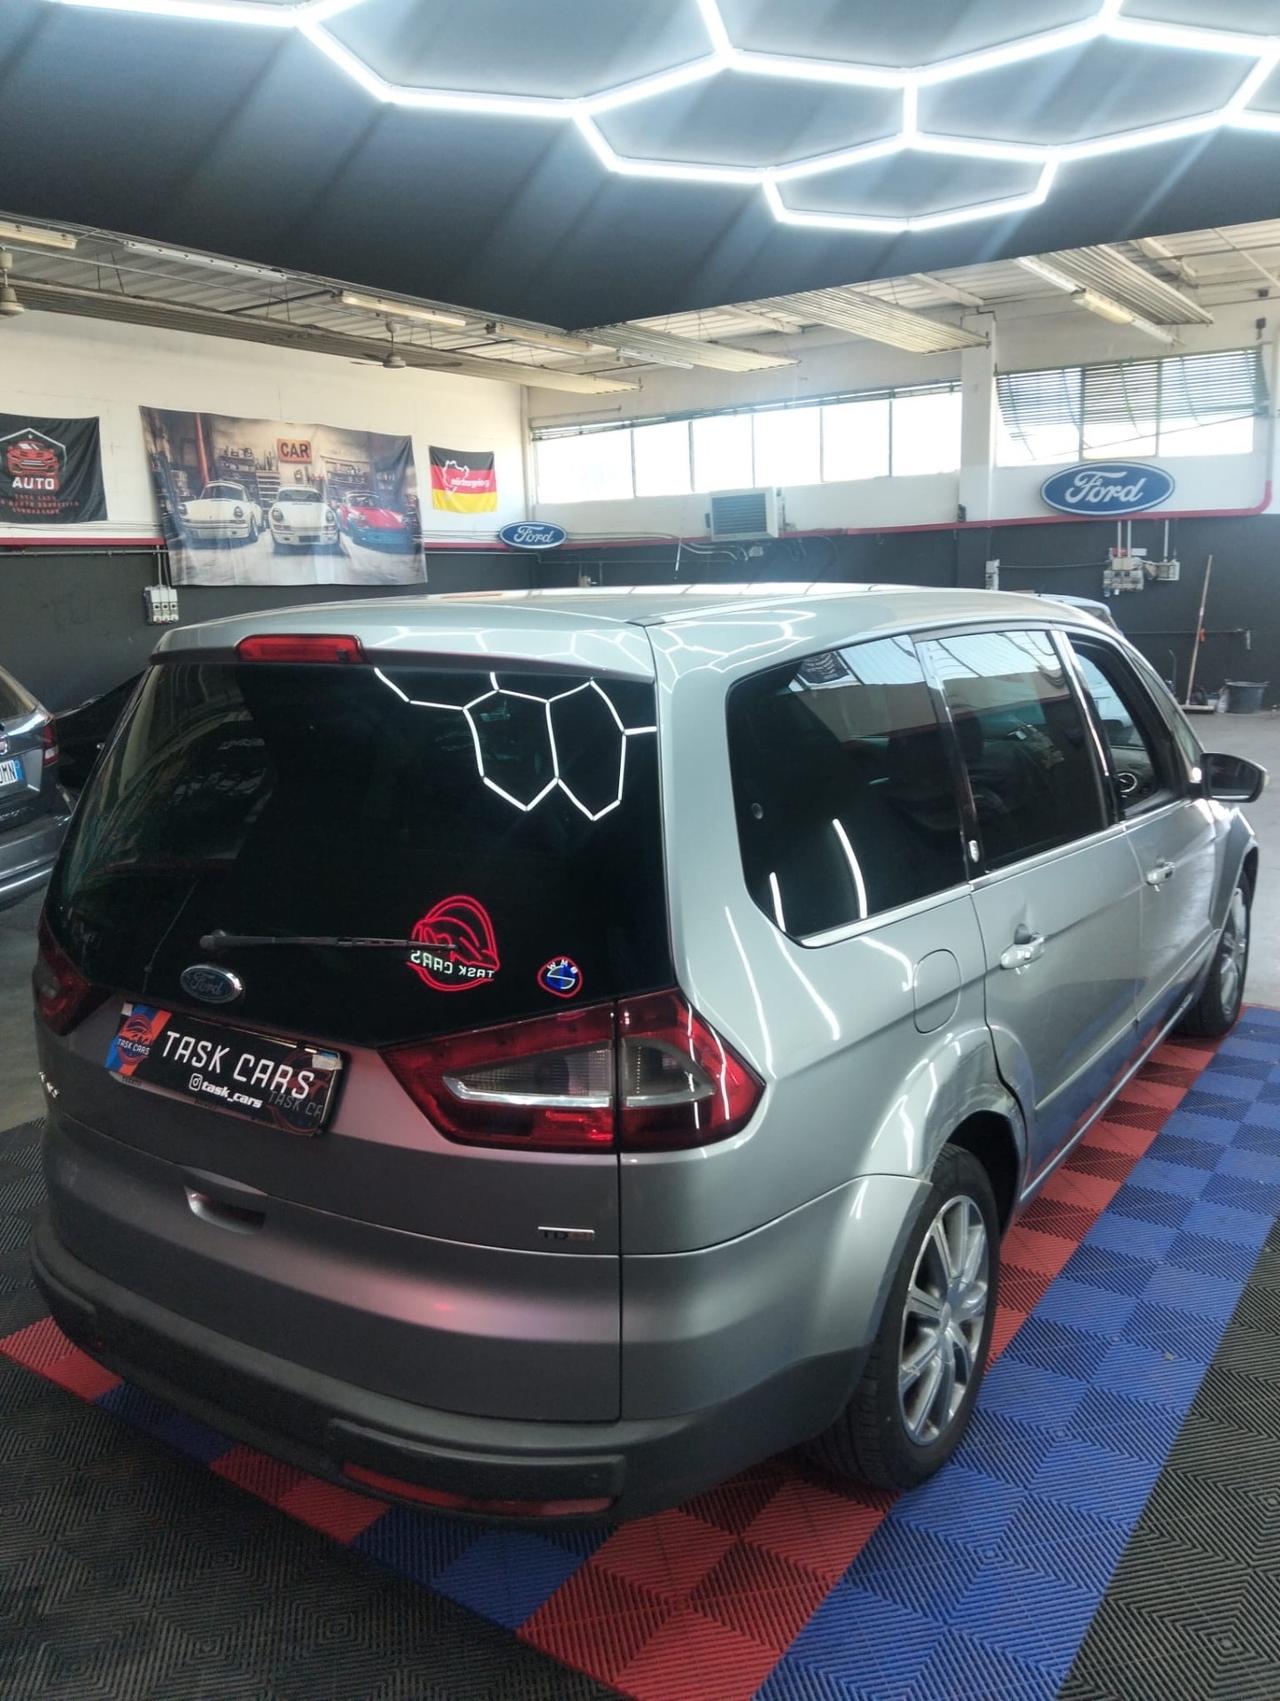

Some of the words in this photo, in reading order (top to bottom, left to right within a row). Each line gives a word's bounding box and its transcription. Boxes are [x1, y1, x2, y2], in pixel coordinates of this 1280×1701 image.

[280, 442, 310, 458] CAR
[12, 476, 55, 490] AUTO
[1064, 470, 1147, 504] Ford
[513, 525, 554, 543] Ford
[191, 971, 224, 996] Ford
[117, 1038, 134, 1050] TASK
[132, 1043, 151, 1056] CARS
[162, 1031, 230, 1074] TASK
[232, 1053, 315, 1099] CARS
[201, 1081, 263, 1109] task_cars
[268, 1090, 303, 1111] TASK
